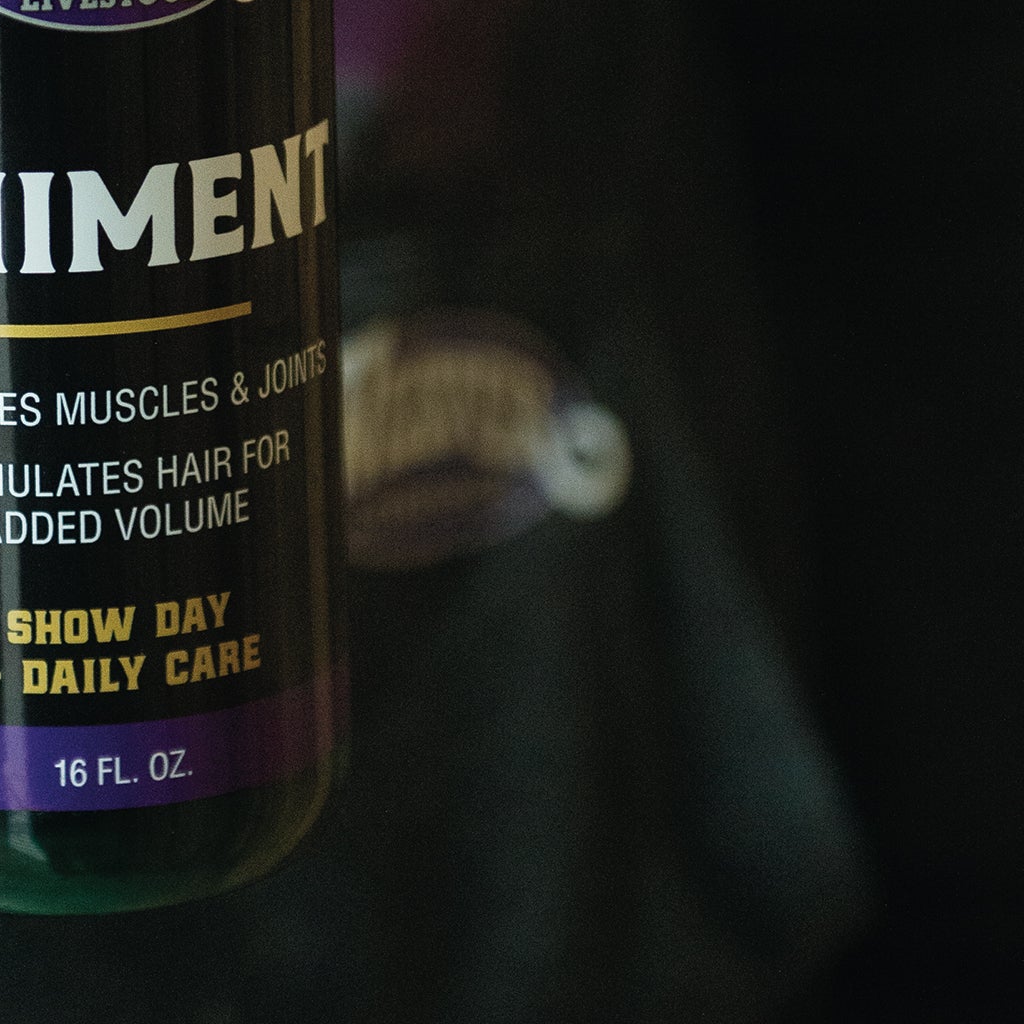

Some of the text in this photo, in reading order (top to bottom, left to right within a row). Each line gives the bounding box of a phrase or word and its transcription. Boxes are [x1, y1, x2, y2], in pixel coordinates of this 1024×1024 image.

[56, 377, 219, 425] MUSCLES
[230, 372, 250, 405] &
[258, 340, 327, 400] JOINTS
[157, 447, 232, 490] HAIR
[243, 430, 291, 474] FOR
[115, 489, 250, 541] VOLUME
[7, 592, 231, 645] SHOW DAY
[22, 656, 146, 695] DAILY
[166, 634, 262, 687] CARE
[54, 749, 193, 788] 16 FL. OZ.
